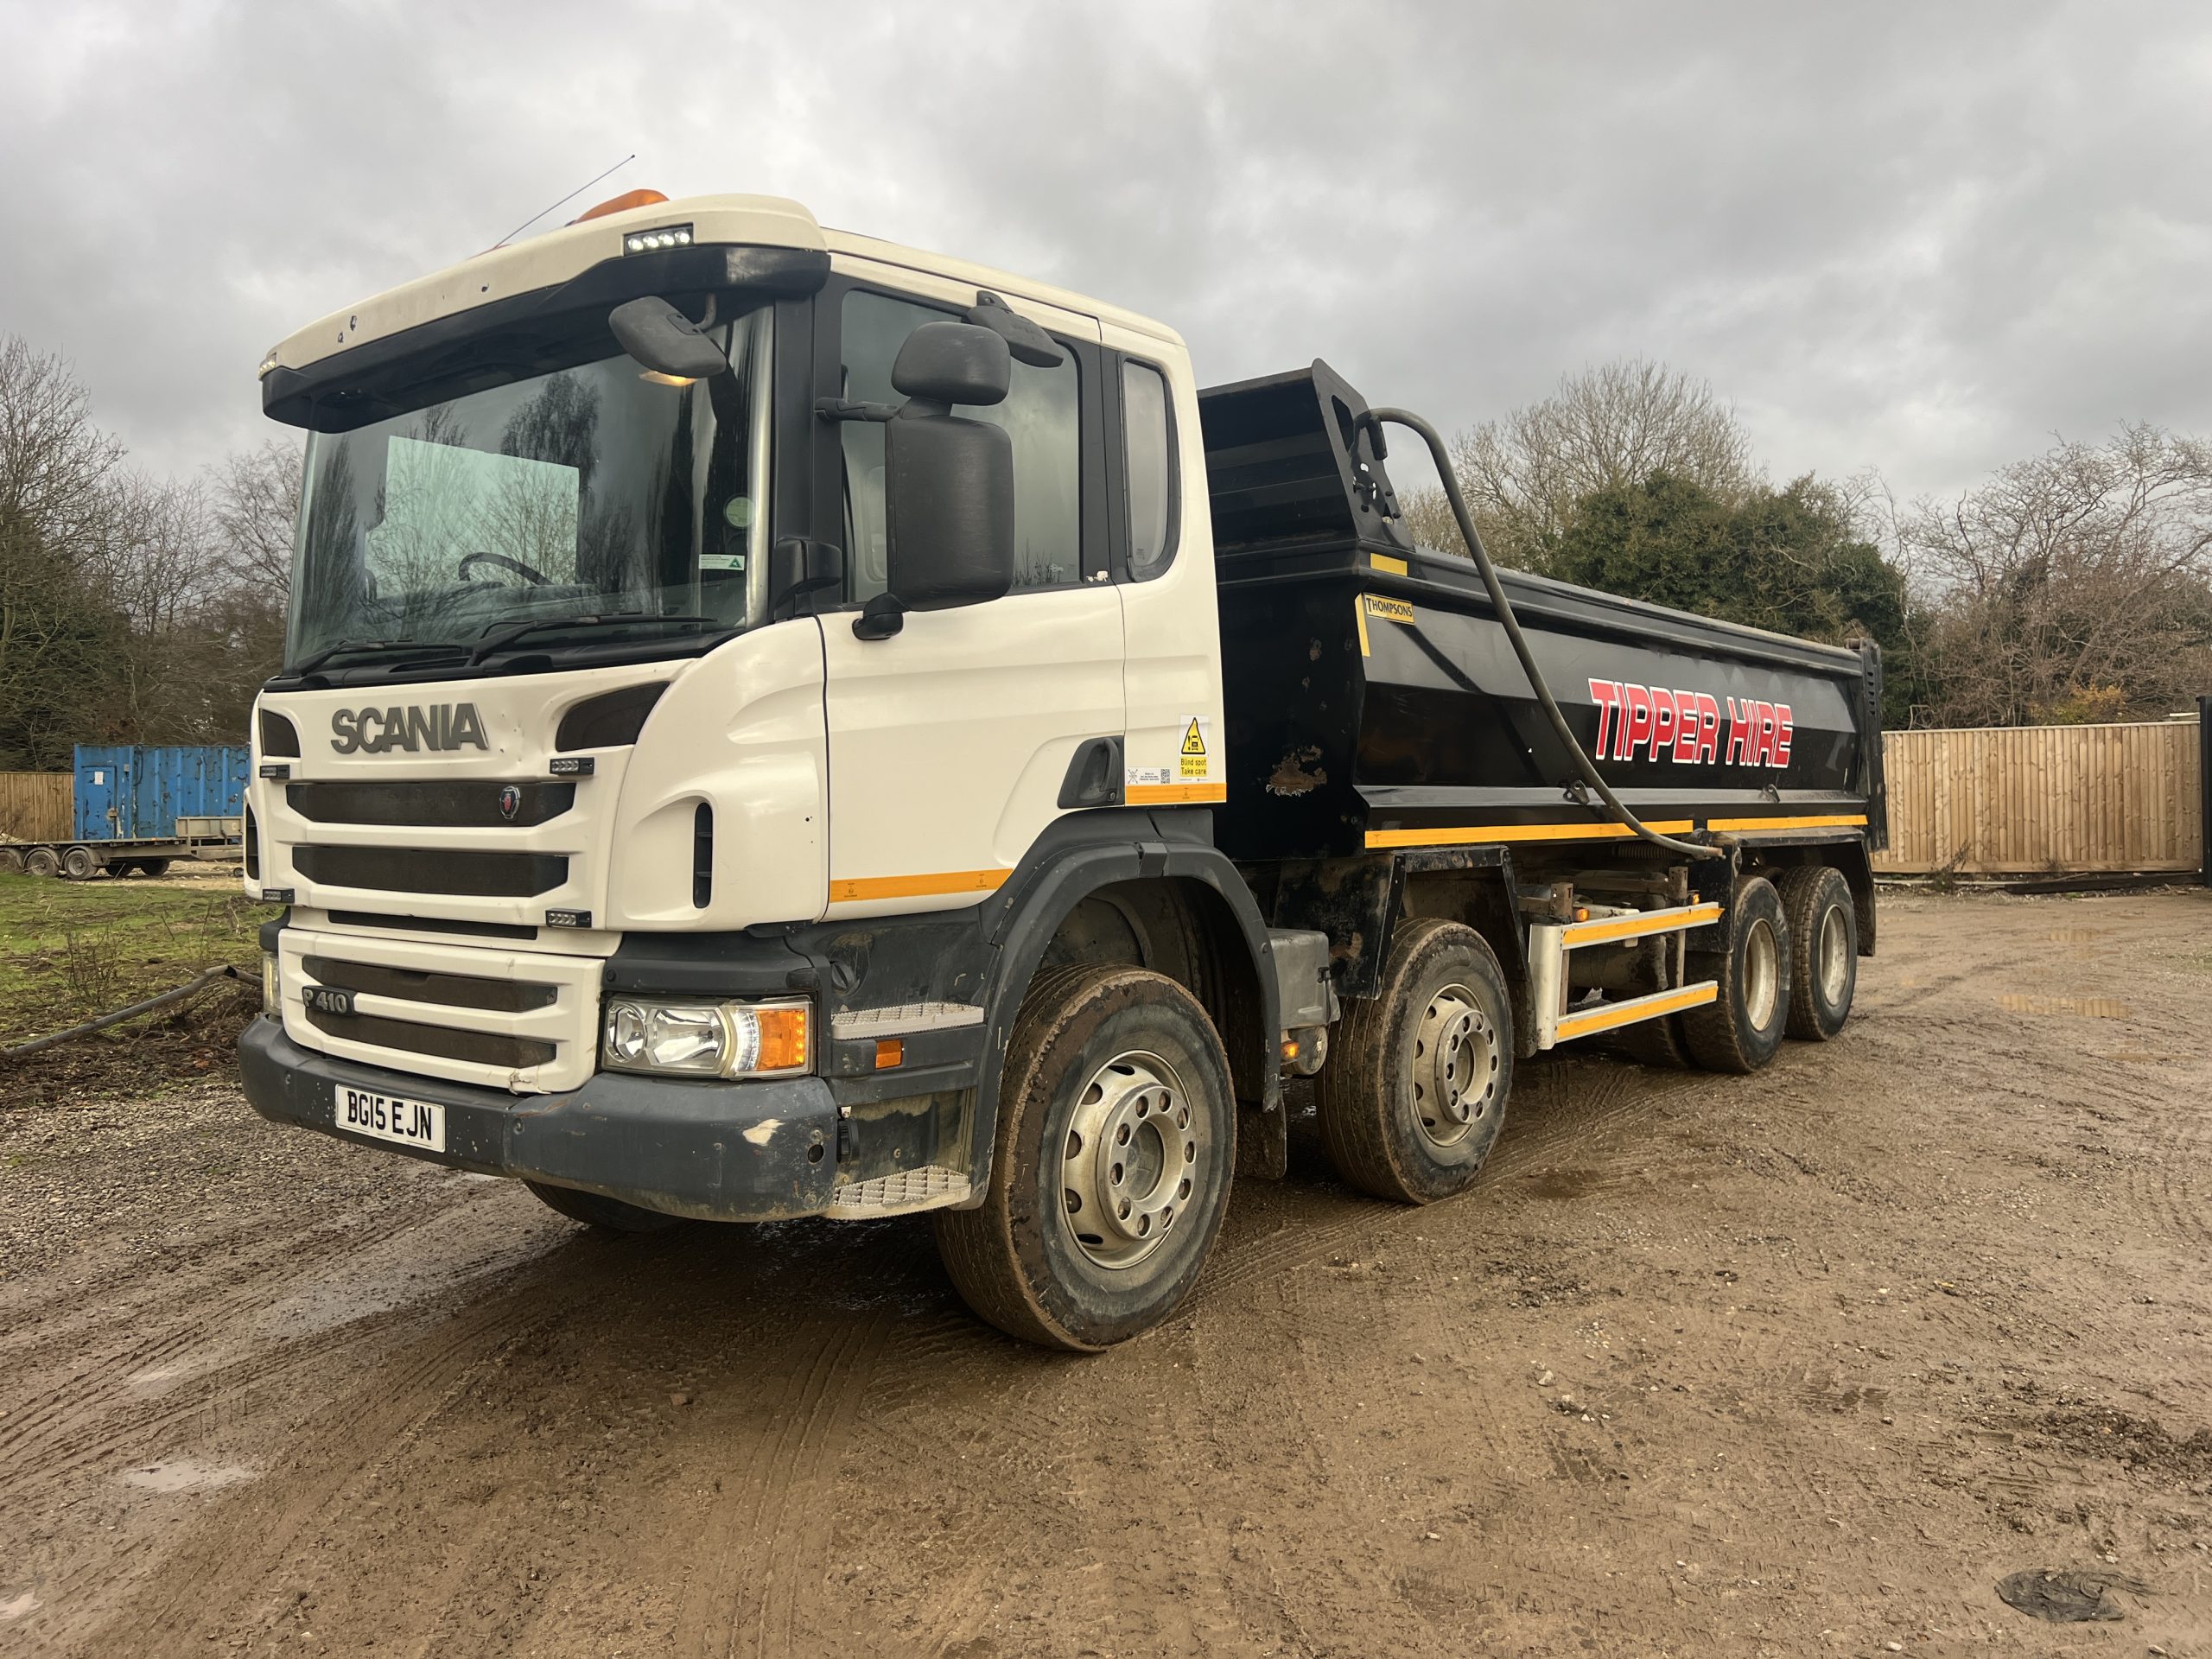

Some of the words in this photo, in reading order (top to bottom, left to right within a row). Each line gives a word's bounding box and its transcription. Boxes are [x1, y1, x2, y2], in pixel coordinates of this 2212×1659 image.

[1366, 597, 1413, 617] THOMPSONS
[330, 702, 491, 755] SCANIA
[1588, 677, 1720, 765] TIPPER
[1726, 696, 1794, 768] HIRE
[1180, 758, 1193, 766] Blind
[1195, 758, 1207, 767] spot
[1180, 766, 1193, 775] Take
[302, 988, 314, 1007] P
[316, 991, 347, 1014] 410
[347, 1090, 386, 1130] BG15
[391, 1100, 432, 1141] EJN
